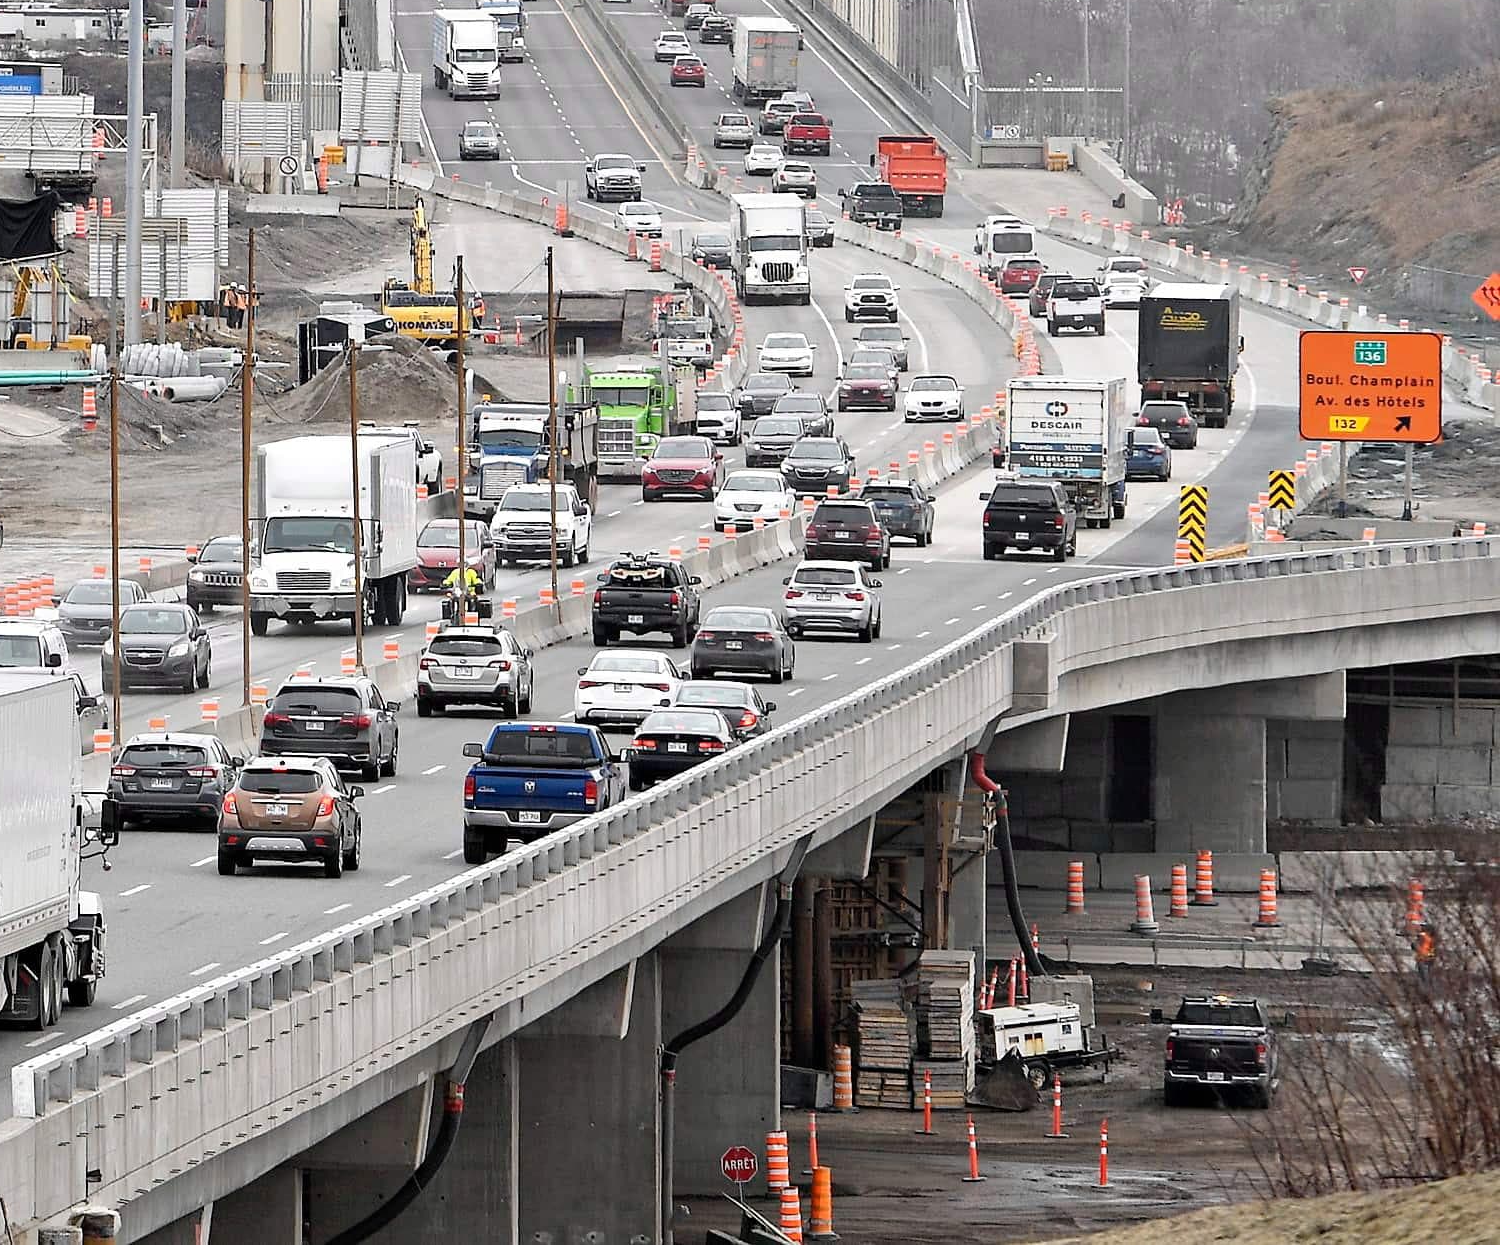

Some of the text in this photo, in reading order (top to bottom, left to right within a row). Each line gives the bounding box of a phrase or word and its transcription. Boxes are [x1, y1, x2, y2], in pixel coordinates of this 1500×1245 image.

[398, 321, 453, 329] KOMATSU
[1359, 350, 1381, 361] 136
[1306, 373, 1434, 389] Boul. Champlain
[1315, 394, 1426, 408] Av. des Hôtels
[1030, 421, 1083, 430] DESCAIR
[1334, 419, 1357, 429] 132
[724, 1156, 755, 1171] ARRÊT
